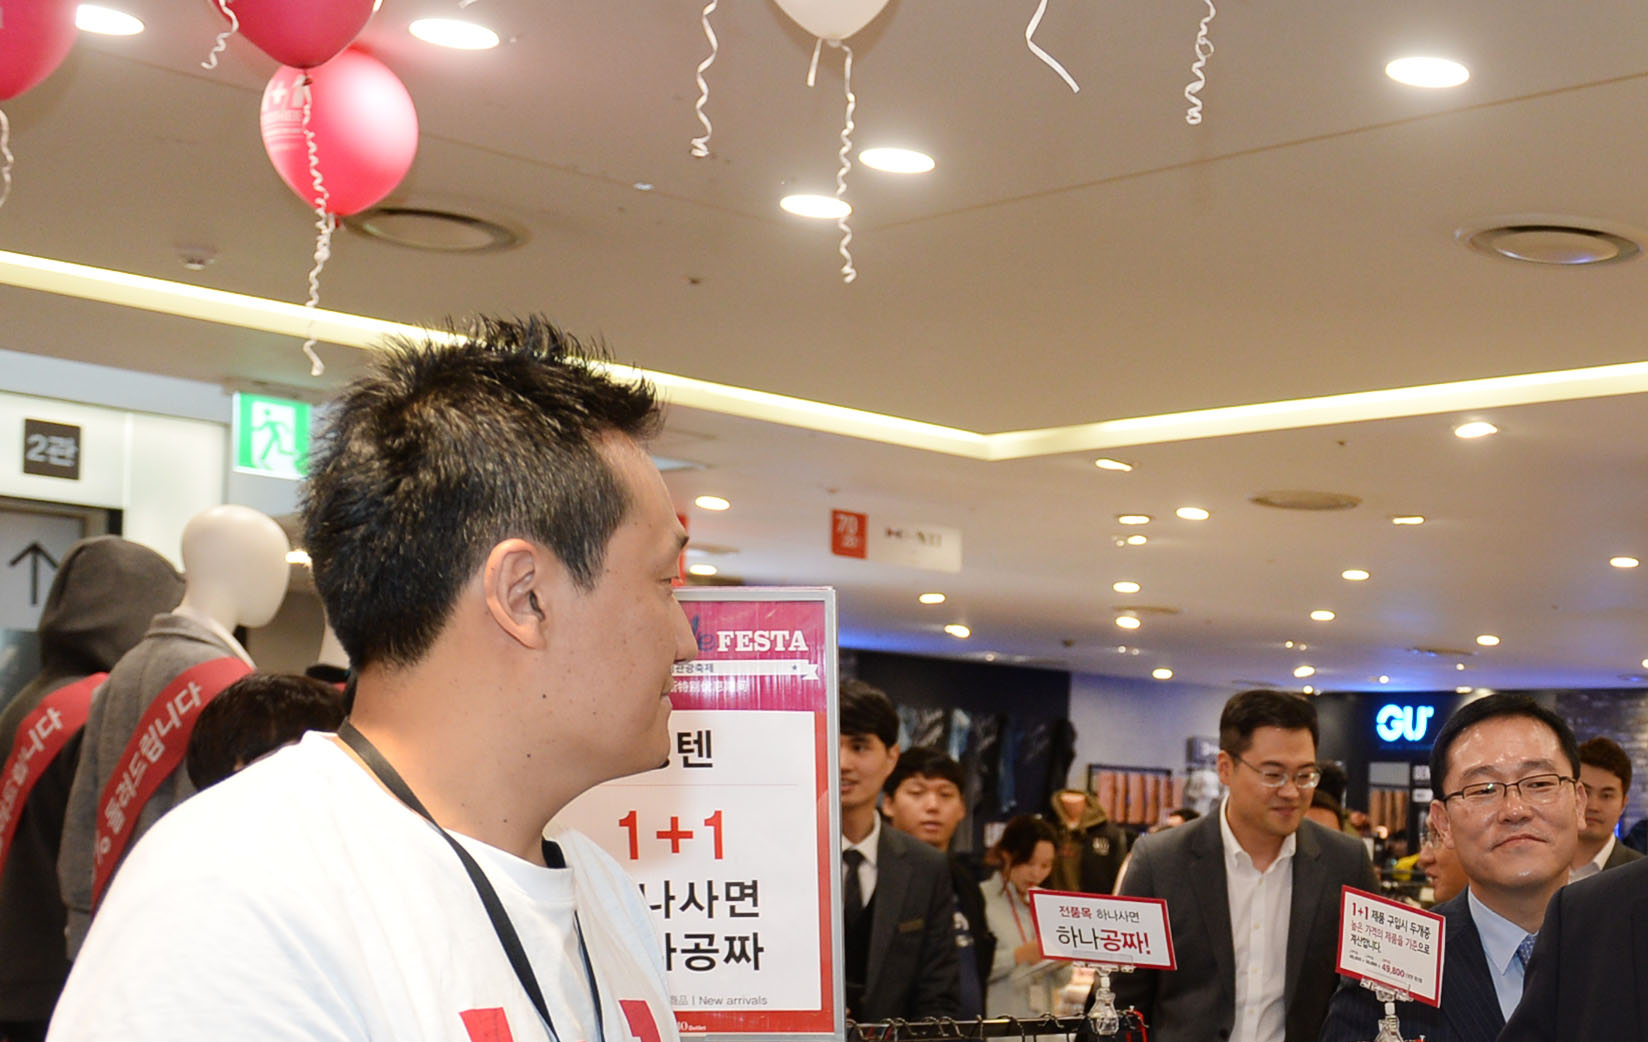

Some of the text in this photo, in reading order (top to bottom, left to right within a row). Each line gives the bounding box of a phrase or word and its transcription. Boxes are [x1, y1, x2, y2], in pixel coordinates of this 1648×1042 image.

[717, 629, 809, 652] FESTA
[618, 810, 724, 860] 1+1
[639, 879, 760, 920] 나사면
[1352, 902, 1369, 920] 1+1
[1059, 905, 1140, 924] 전품목 하나사면
[1056, 925, 1151, 955] 하나공짜!
